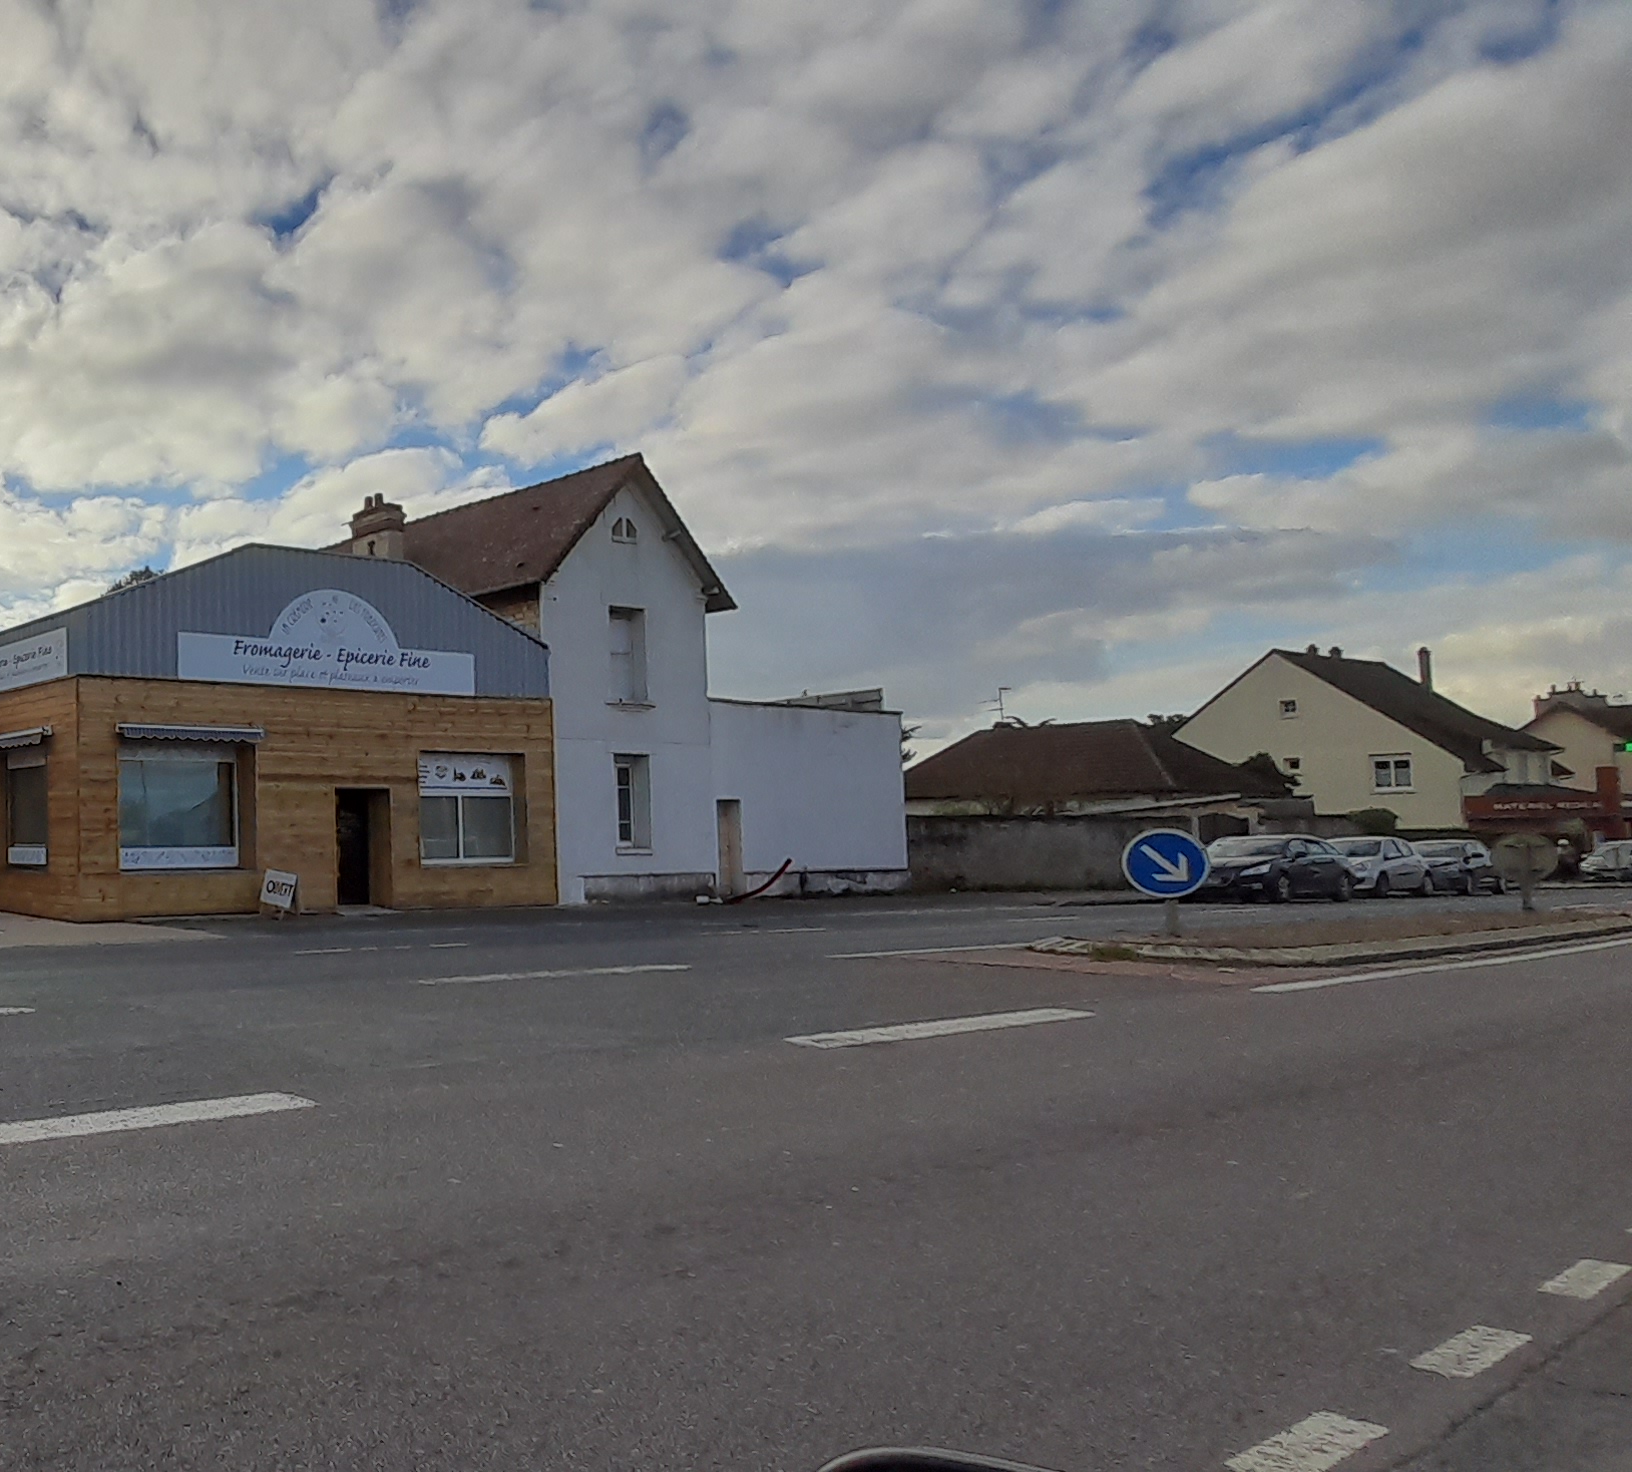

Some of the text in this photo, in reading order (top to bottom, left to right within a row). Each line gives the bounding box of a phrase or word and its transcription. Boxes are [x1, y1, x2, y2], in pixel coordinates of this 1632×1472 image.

[233, 639, 323, 668] Fromagerie
[337, 648, 396, 671] Epicerie
[399, 651, 431, 668] Fine
